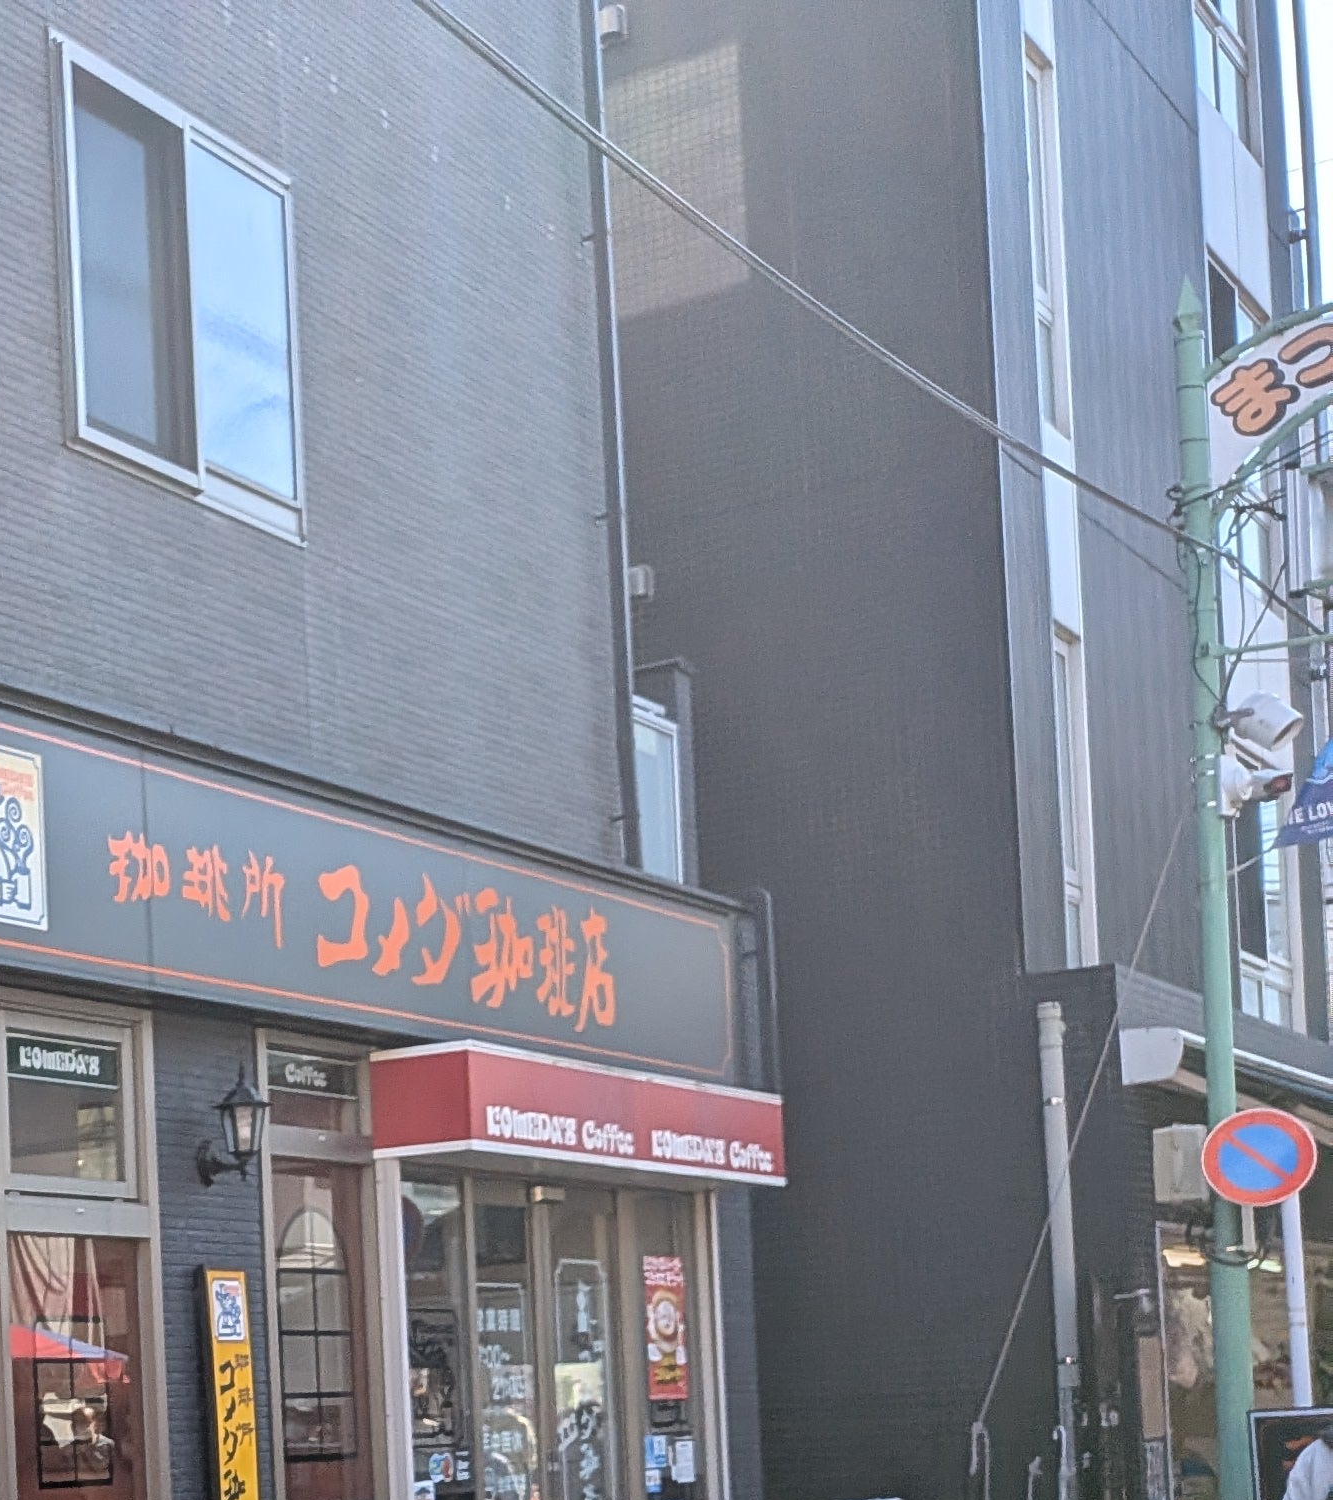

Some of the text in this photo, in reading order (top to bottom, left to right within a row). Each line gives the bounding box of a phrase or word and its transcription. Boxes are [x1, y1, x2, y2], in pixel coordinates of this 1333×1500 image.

[317, 865, 615, 1032] コメダ珈琲店
[19, 1045, 100, 1077] KOMEDA'S
[285, 1063, 327, 1087] Coffee
[486, 1105, 773, 1172] KOMEDA'S Coffee KOMEDA'S Coffee
